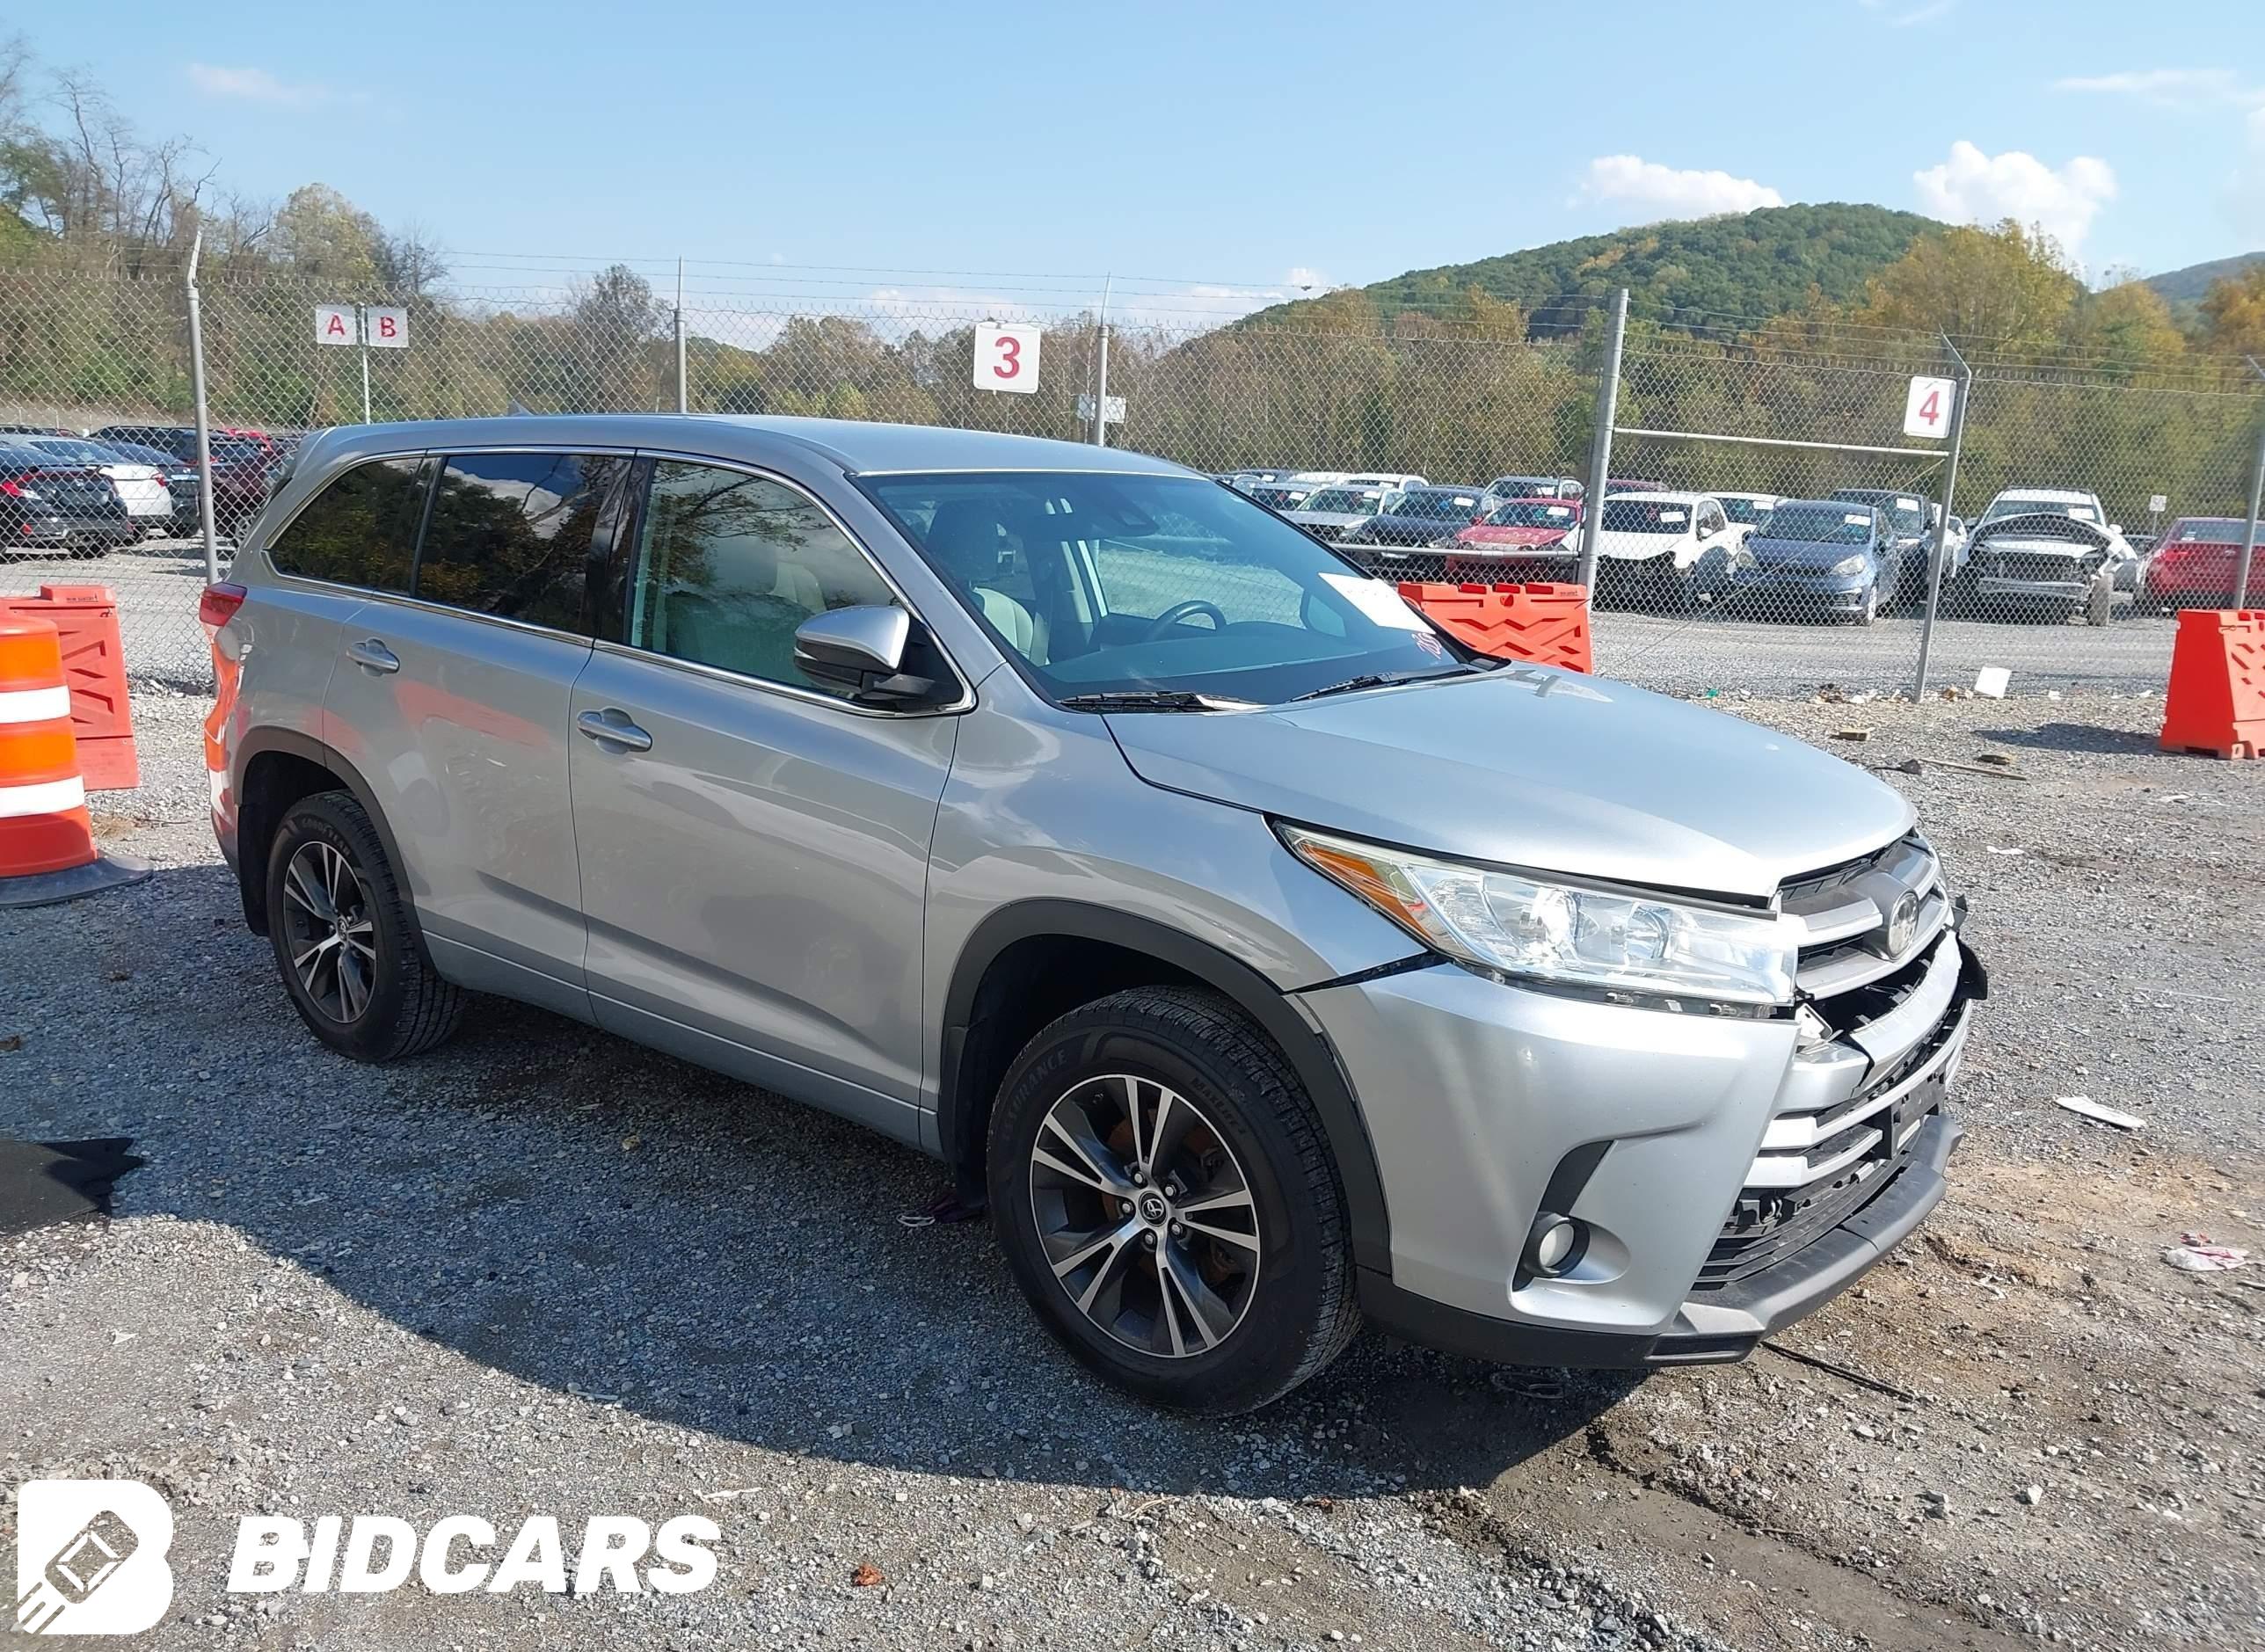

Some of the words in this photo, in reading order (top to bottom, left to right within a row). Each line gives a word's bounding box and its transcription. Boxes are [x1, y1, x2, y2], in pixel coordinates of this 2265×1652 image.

[327, 314, 346, 335] A
[380, 317, 397, 337] B
[994, 336, 1021, 379] 3
[1919, 390, 1940, 426] 4
